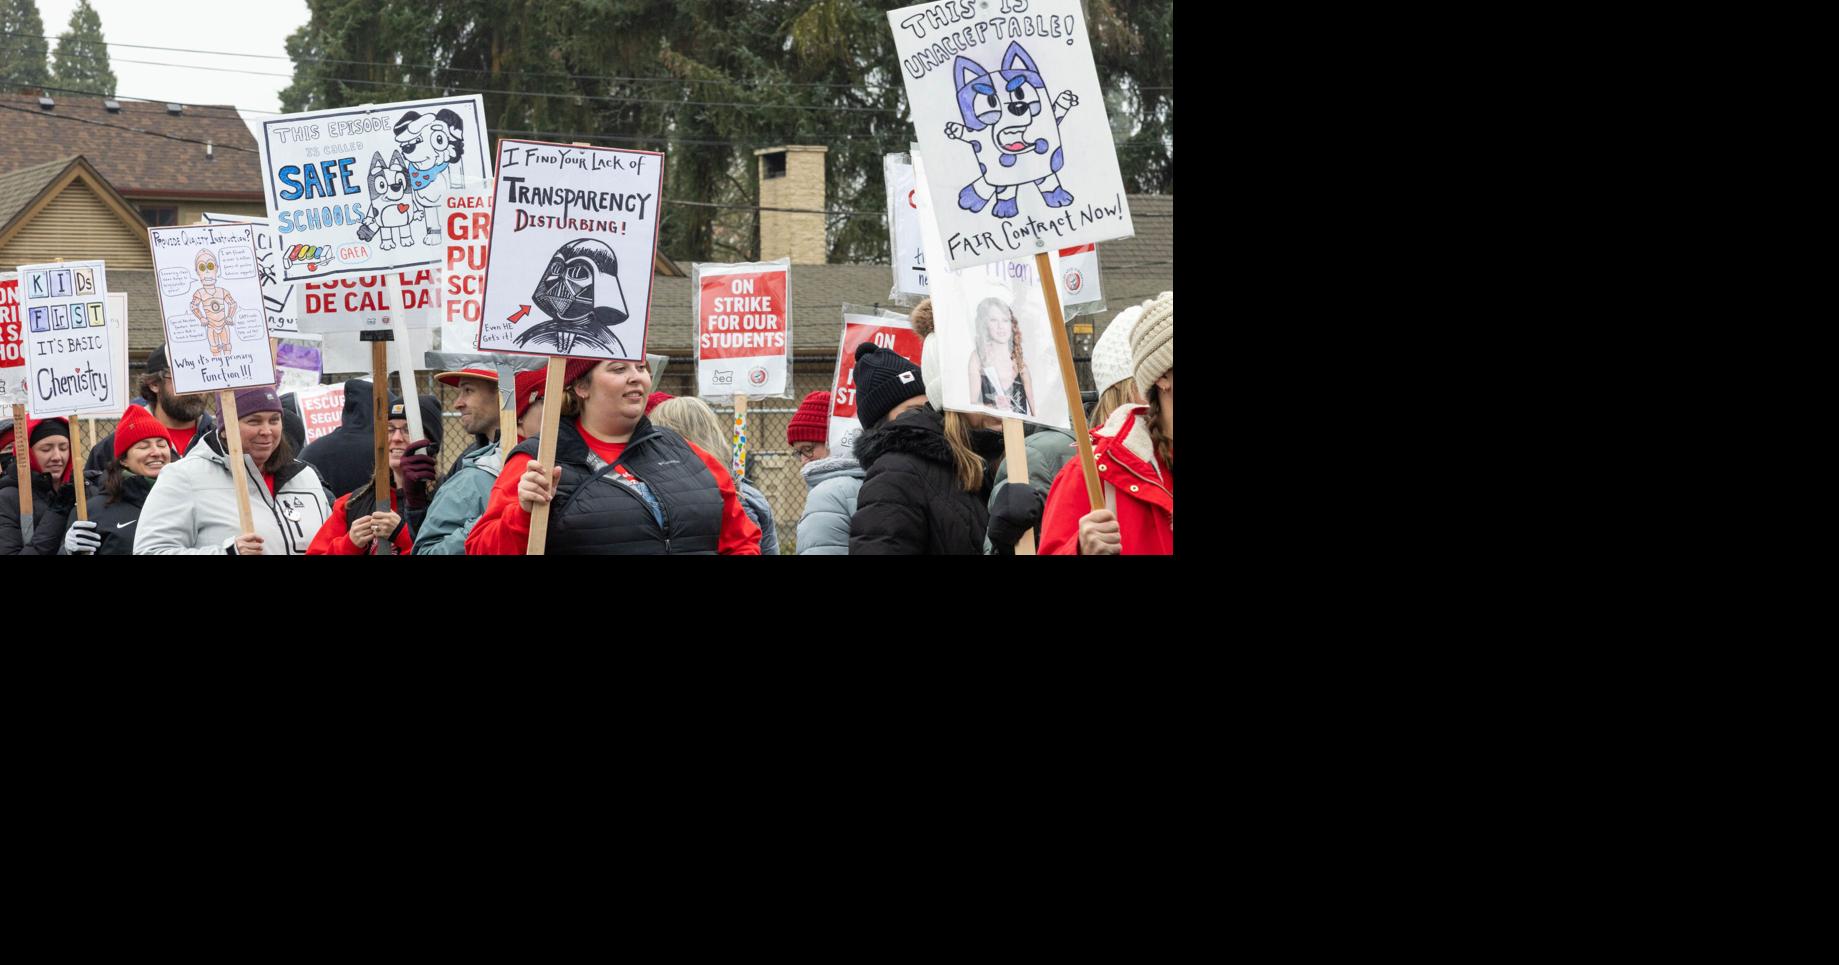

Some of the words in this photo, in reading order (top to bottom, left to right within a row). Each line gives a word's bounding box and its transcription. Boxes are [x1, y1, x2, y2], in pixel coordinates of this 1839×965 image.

[900, 0, 976, 39] THIS
[903, 15, 1075, 79] UNACCEPTABLE!
[273, 124, 321, 143] THIS
[328, 116, 391, 138] EPISODE
[323, 141, 364, 156] CALLED
[502, 147, 520, 169] I
[629, 156, 647, 176] of
[278, 156, 362, 201] SAFE
[447, 196, 484, 209] GAEA
[503, 176, 652, 220] TRANSPARENCY
[278, 202, 367, 234] SCHOOLS
[514, 208, 627, 236] DISTURBING!
[339, 246, 369, 260] GAEA
[948, 230, 1003, 261] FAIR
[731, 278, 754, 295] ON
[305, 292, 337, 314] DE
[714, 296, 771, 313] STRIKE
[708, 314, 740, 331] FOR
[742, 313, 777, 330] OUR
[37, 338, 64, 356] IT'S
[68, 335, 103, 353] BASIC
[701, 331, 785, 349] STUDENTS
[874, 332, 896, 350] ON
[174, 356, 196, 370] Why
[211, 356, 224, 367] my
[224, 353, 254, 367] primary
[37, 360, 109, 402] Chemistry
